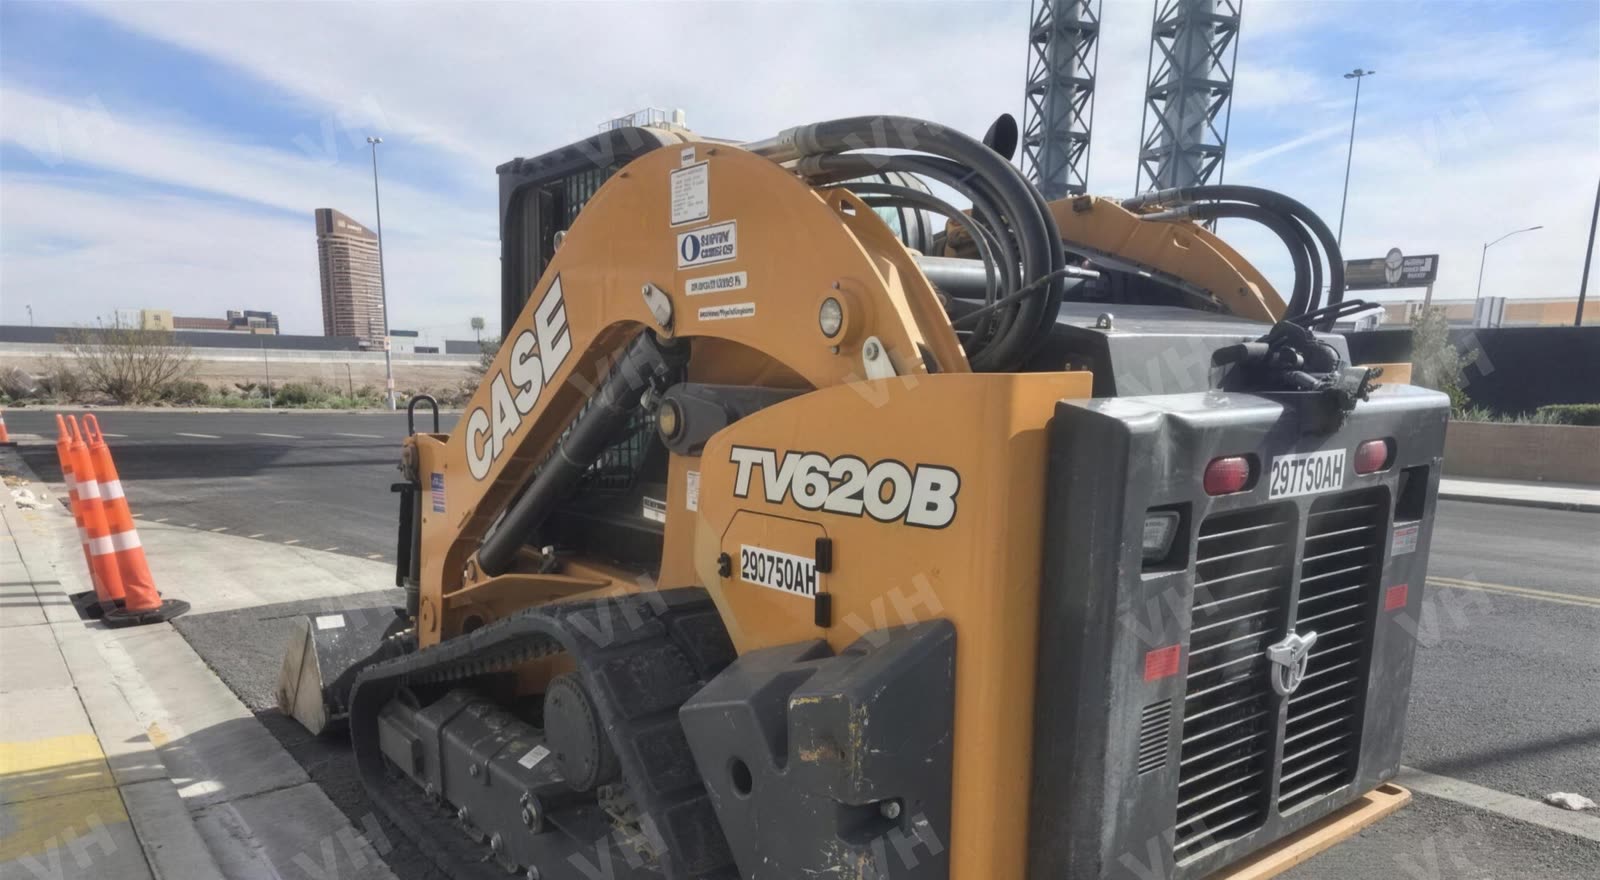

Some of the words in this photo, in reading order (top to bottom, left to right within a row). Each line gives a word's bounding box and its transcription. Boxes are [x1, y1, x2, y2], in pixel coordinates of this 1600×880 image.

[465, 272, 572, 481] CASE
[729, 444, 961, 529] TV620B
[1271, 453, 1344, 496] 297750AH
[742, 549, 817, 595] 290750AH
